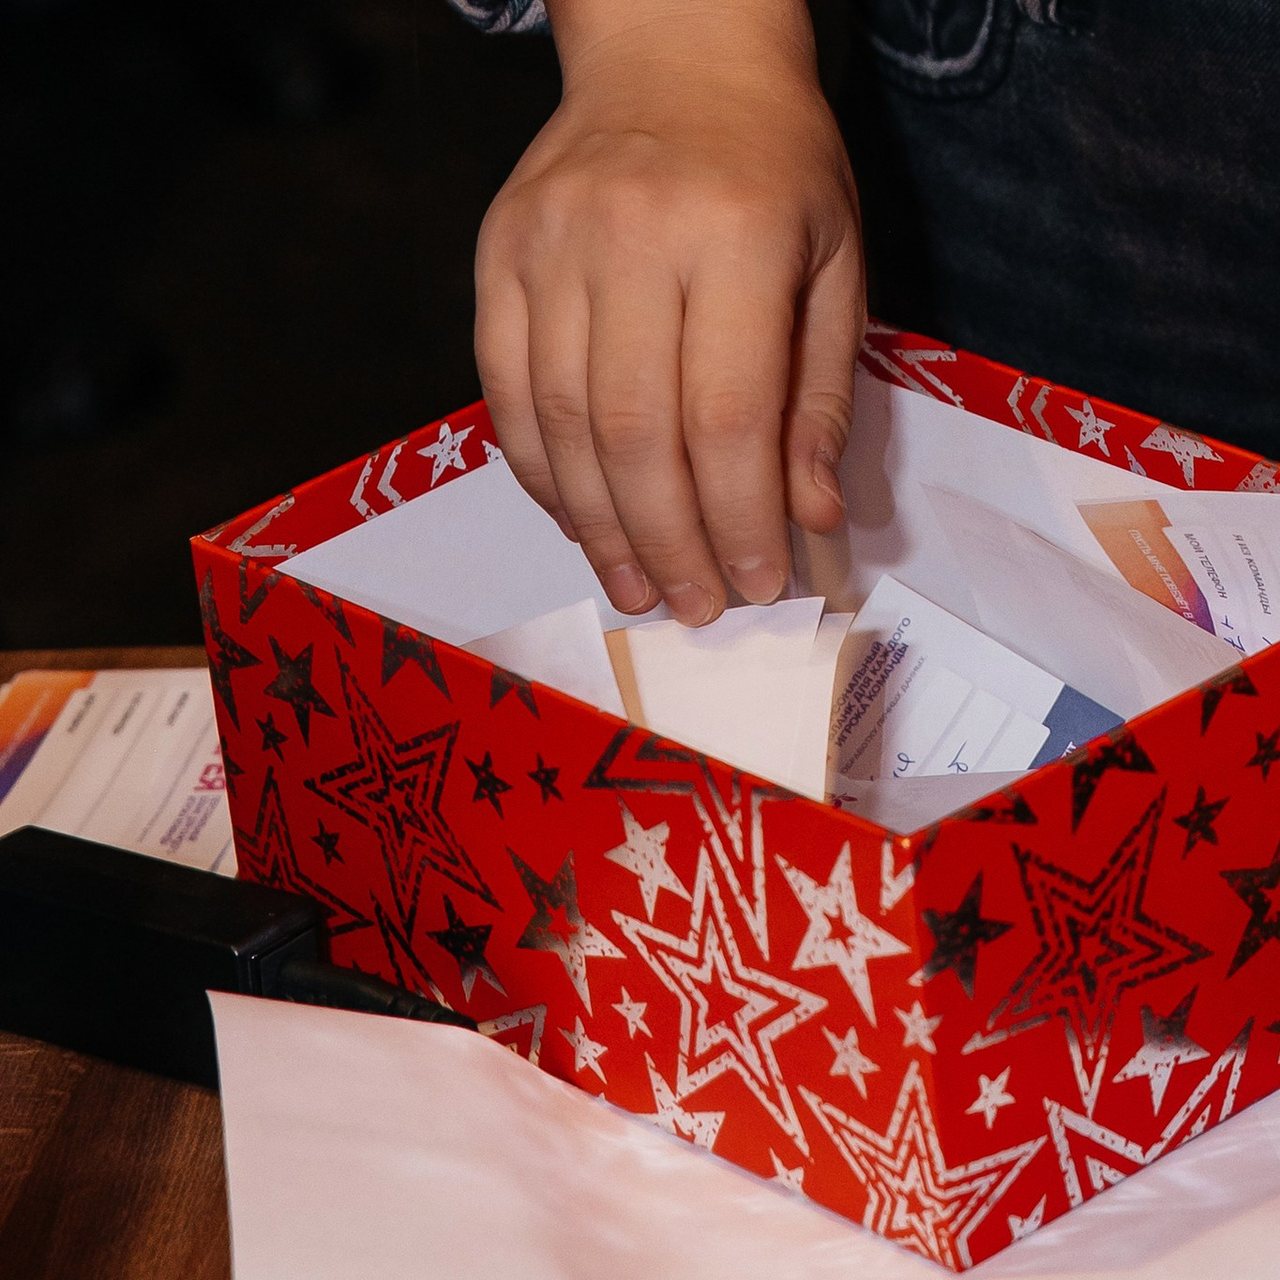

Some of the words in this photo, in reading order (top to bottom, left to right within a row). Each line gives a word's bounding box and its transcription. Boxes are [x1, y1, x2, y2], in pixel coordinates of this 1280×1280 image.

[1147, 555, 1166, 576] МНЕ
[1198, 555, 1228, 599] ТЕЛЕФОН
[1232, 533, 1243, 541] Я
[1238, 542, 1251, 556] ИЗ
[1246, 556, 1272, 615] КОМАНДЫ
[833, 640, 884, 714] СОНАЛЬНЫЙ
[835, 703, 870, 747] ИГРОКА
[867, 642, 909, 702] КОМАНДЫ
[853, 675, 873, 704] ДЛЯ
[870, 617, 911, 677] КАЖДОГО
